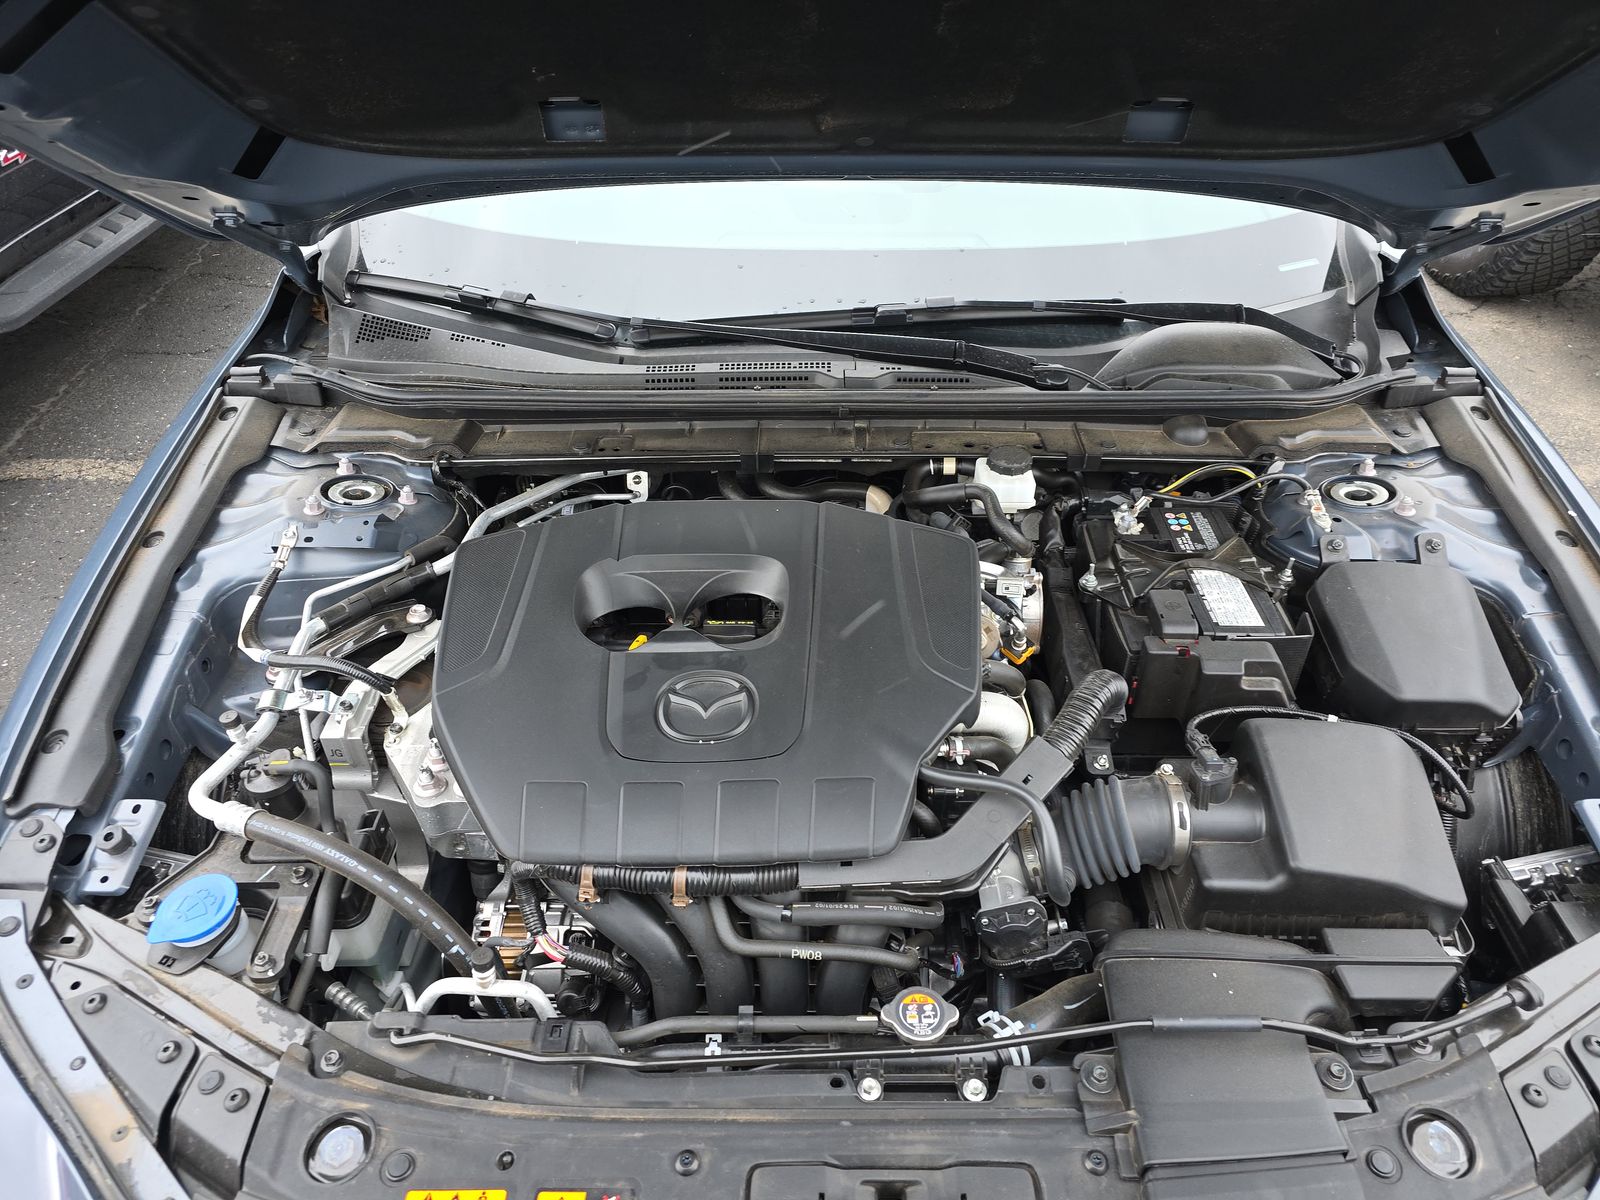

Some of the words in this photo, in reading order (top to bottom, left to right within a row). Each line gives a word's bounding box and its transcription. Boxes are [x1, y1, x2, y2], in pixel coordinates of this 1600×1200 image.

[330, 749, 344, 758] JG
[323, 848, 359, 867] GALAXY
[791, 948, 823, 961] PW08
